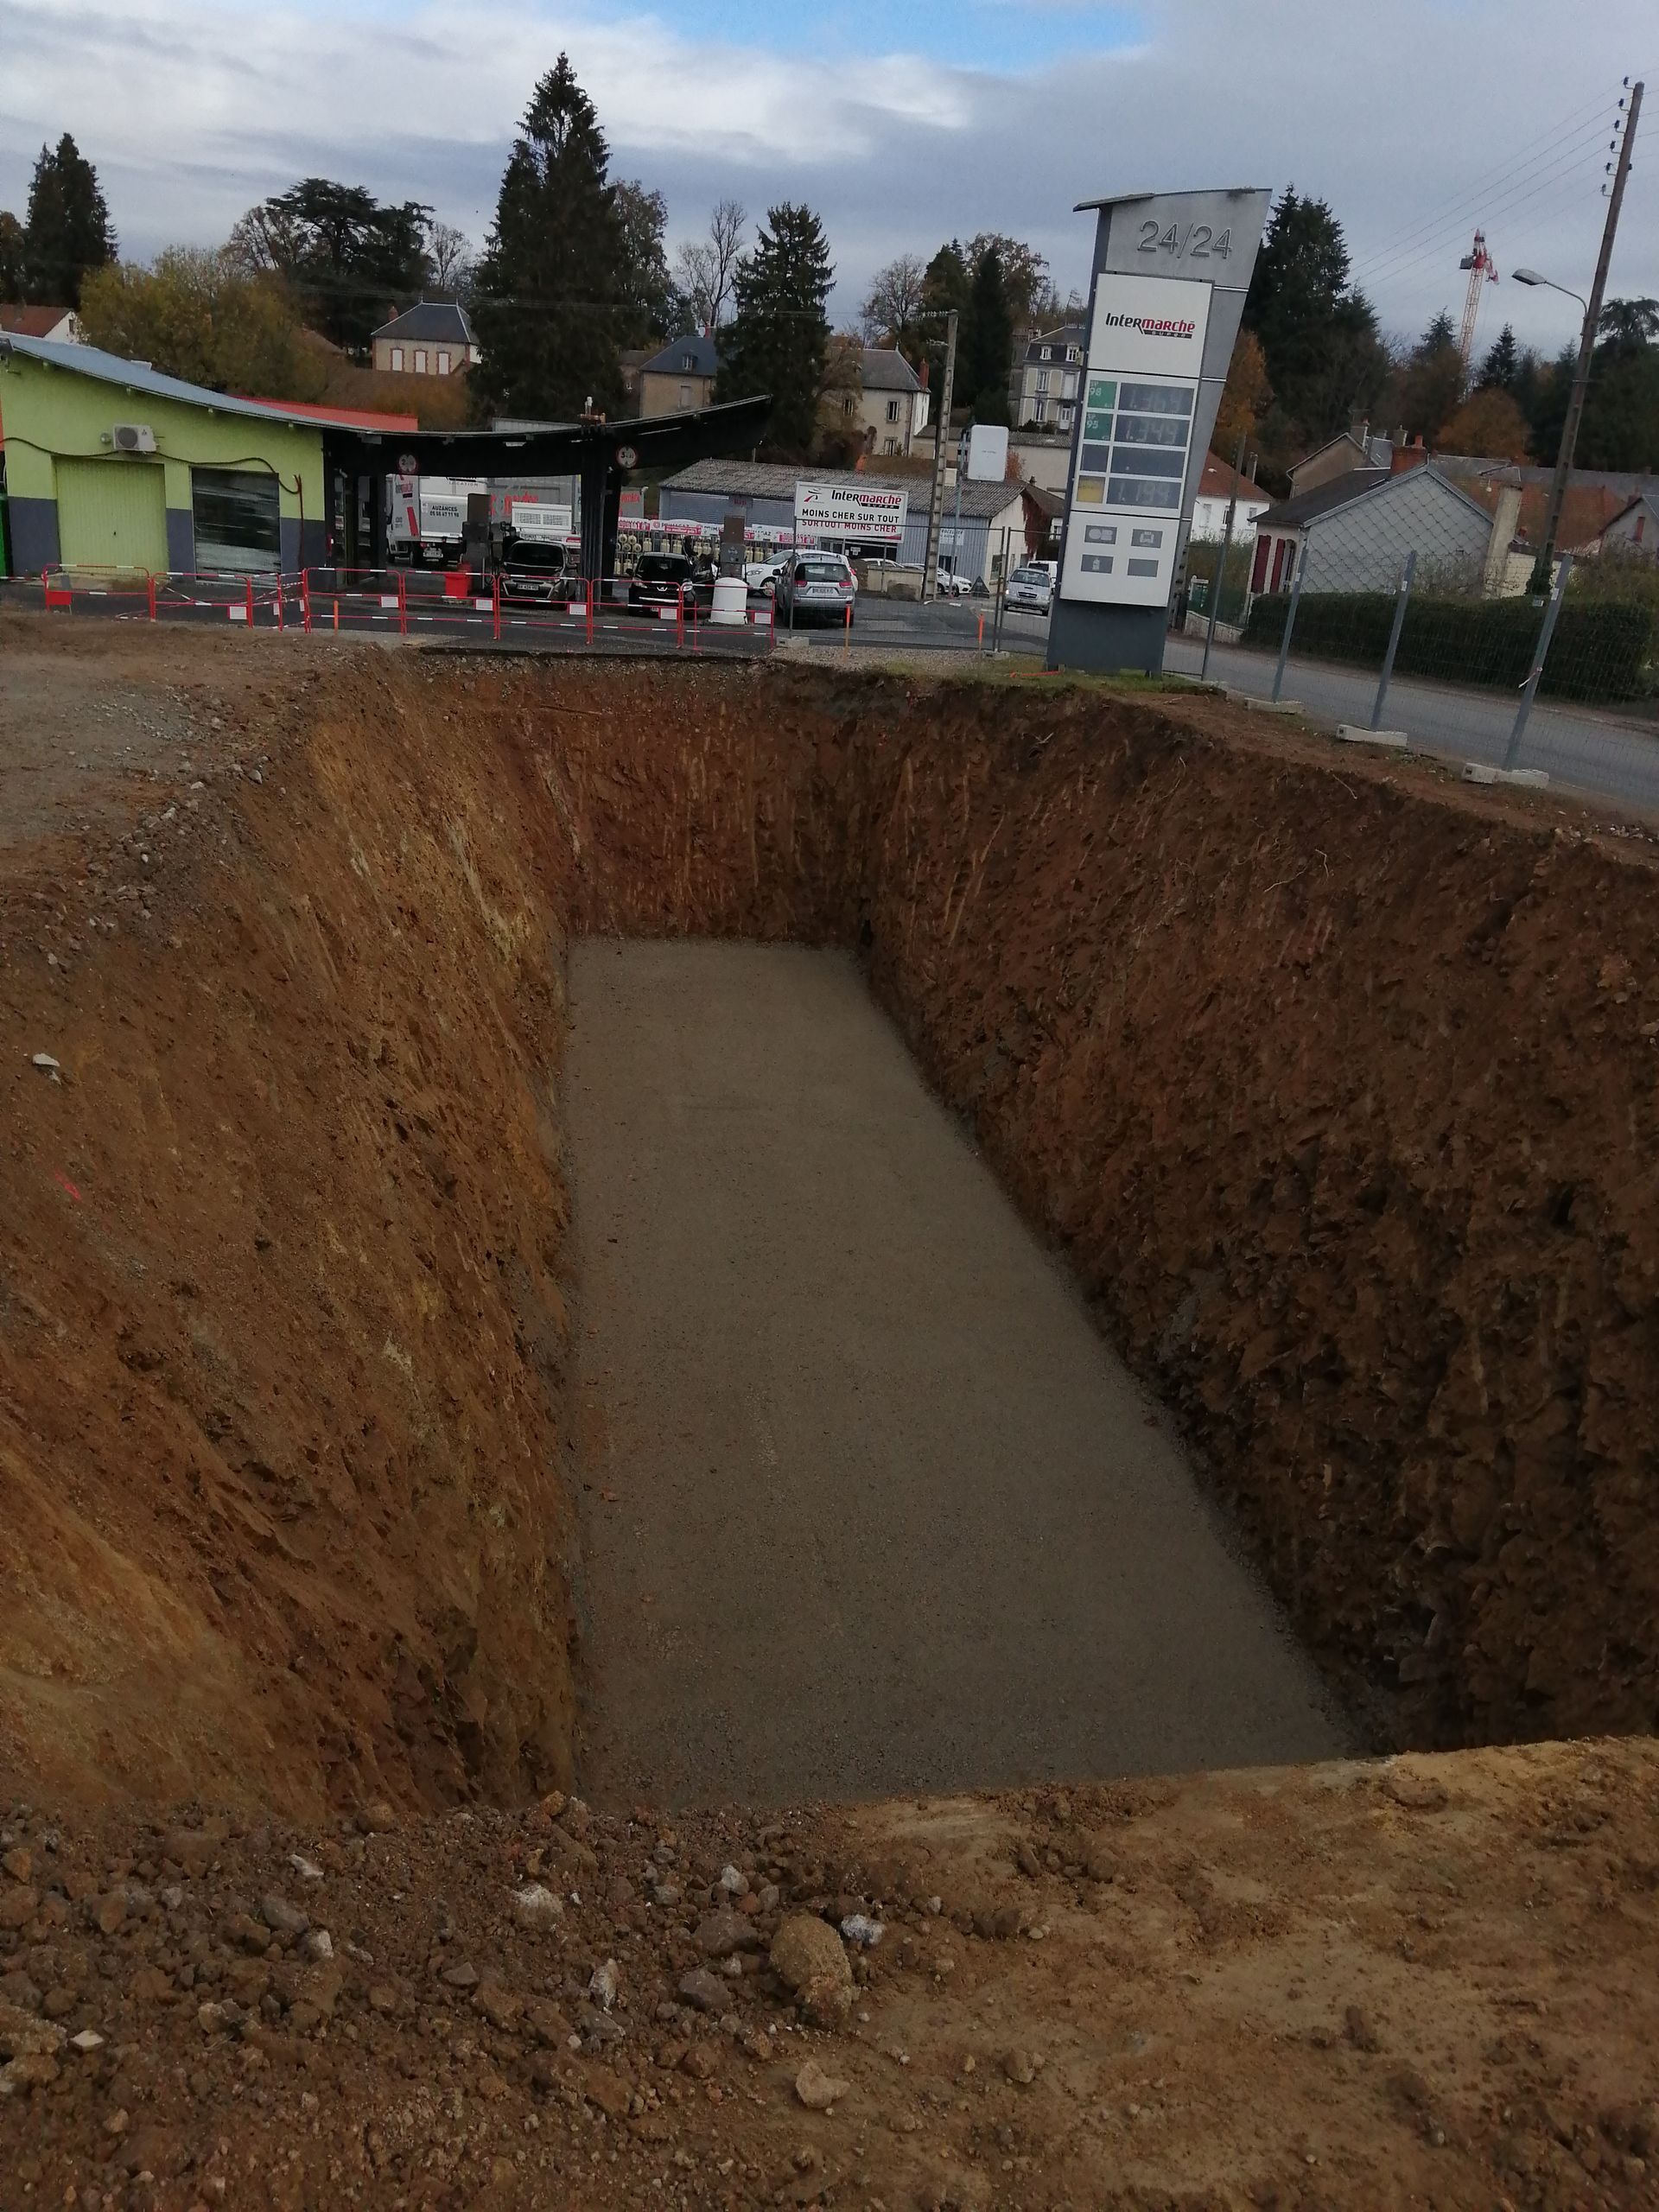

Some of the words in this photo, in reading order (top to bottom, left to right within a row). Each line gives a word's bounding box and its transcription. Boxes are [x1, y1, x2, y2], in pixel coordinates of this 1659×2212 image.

[1137, 220, 1232, 259] 24/24
[1090, 387, 1102, 397] 98
[1086, 420, 1099, 429] 95
[802, 508, 830, 518] MOINS
[832, 511, 855, 520] CHER
[857, 513, 874, 522] SUR
[877, 514, 899, 524] TOUT
[802, 520, 841, 529] SURTOUT
[844, 522, 872, 531] MOINS
[874, 524, 897, 533] CHER
